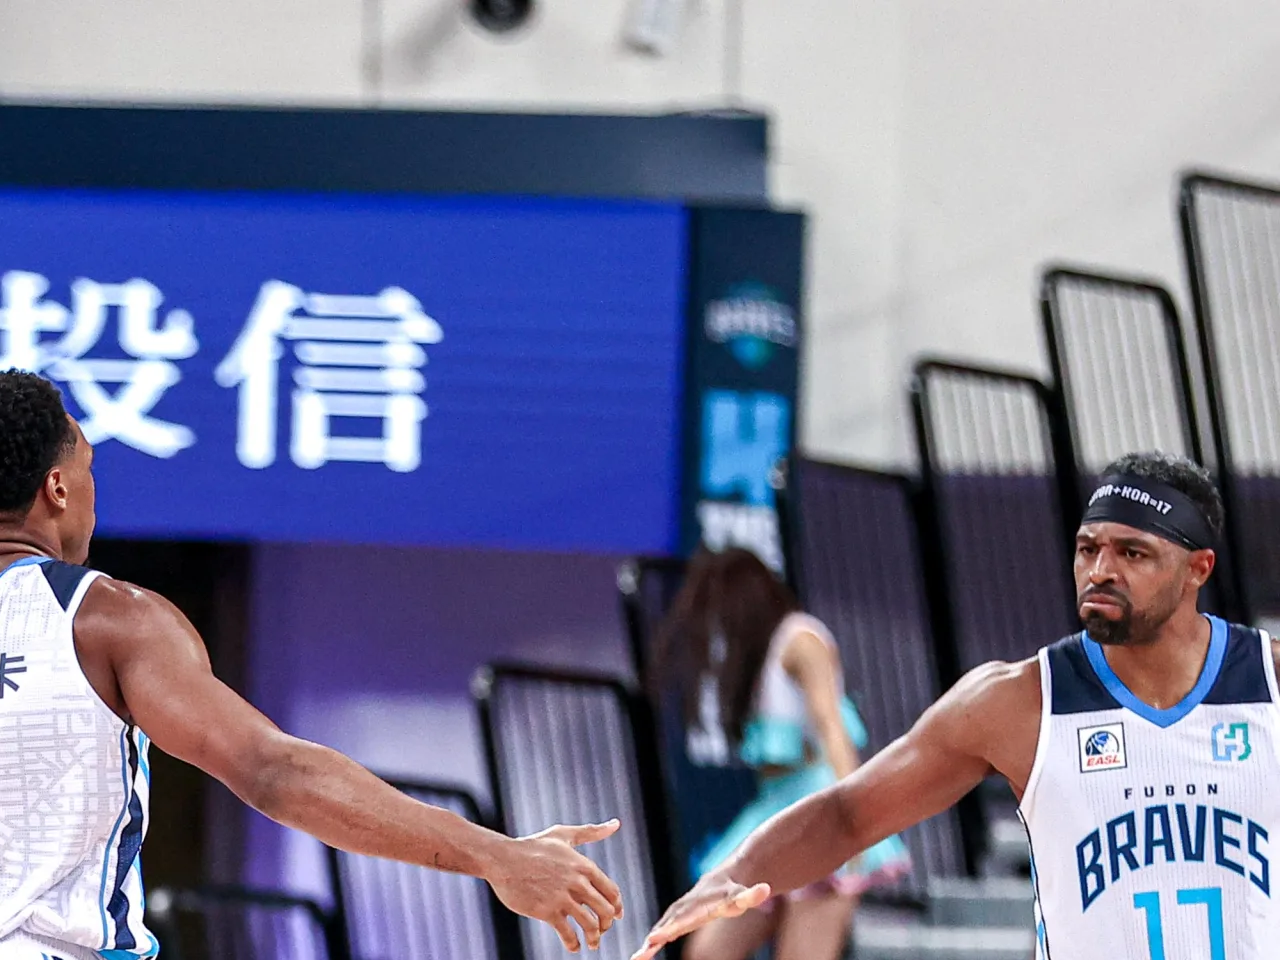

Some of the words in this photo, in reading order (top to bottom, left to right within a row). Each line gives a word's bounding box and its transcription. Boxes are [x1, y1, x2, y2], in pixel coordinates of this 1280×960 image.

[1086, 755, 1121, 767] EASL
[1124, 783, 1218, 800] FUBON
[1075, 803, 1272, 914] BRAVES
